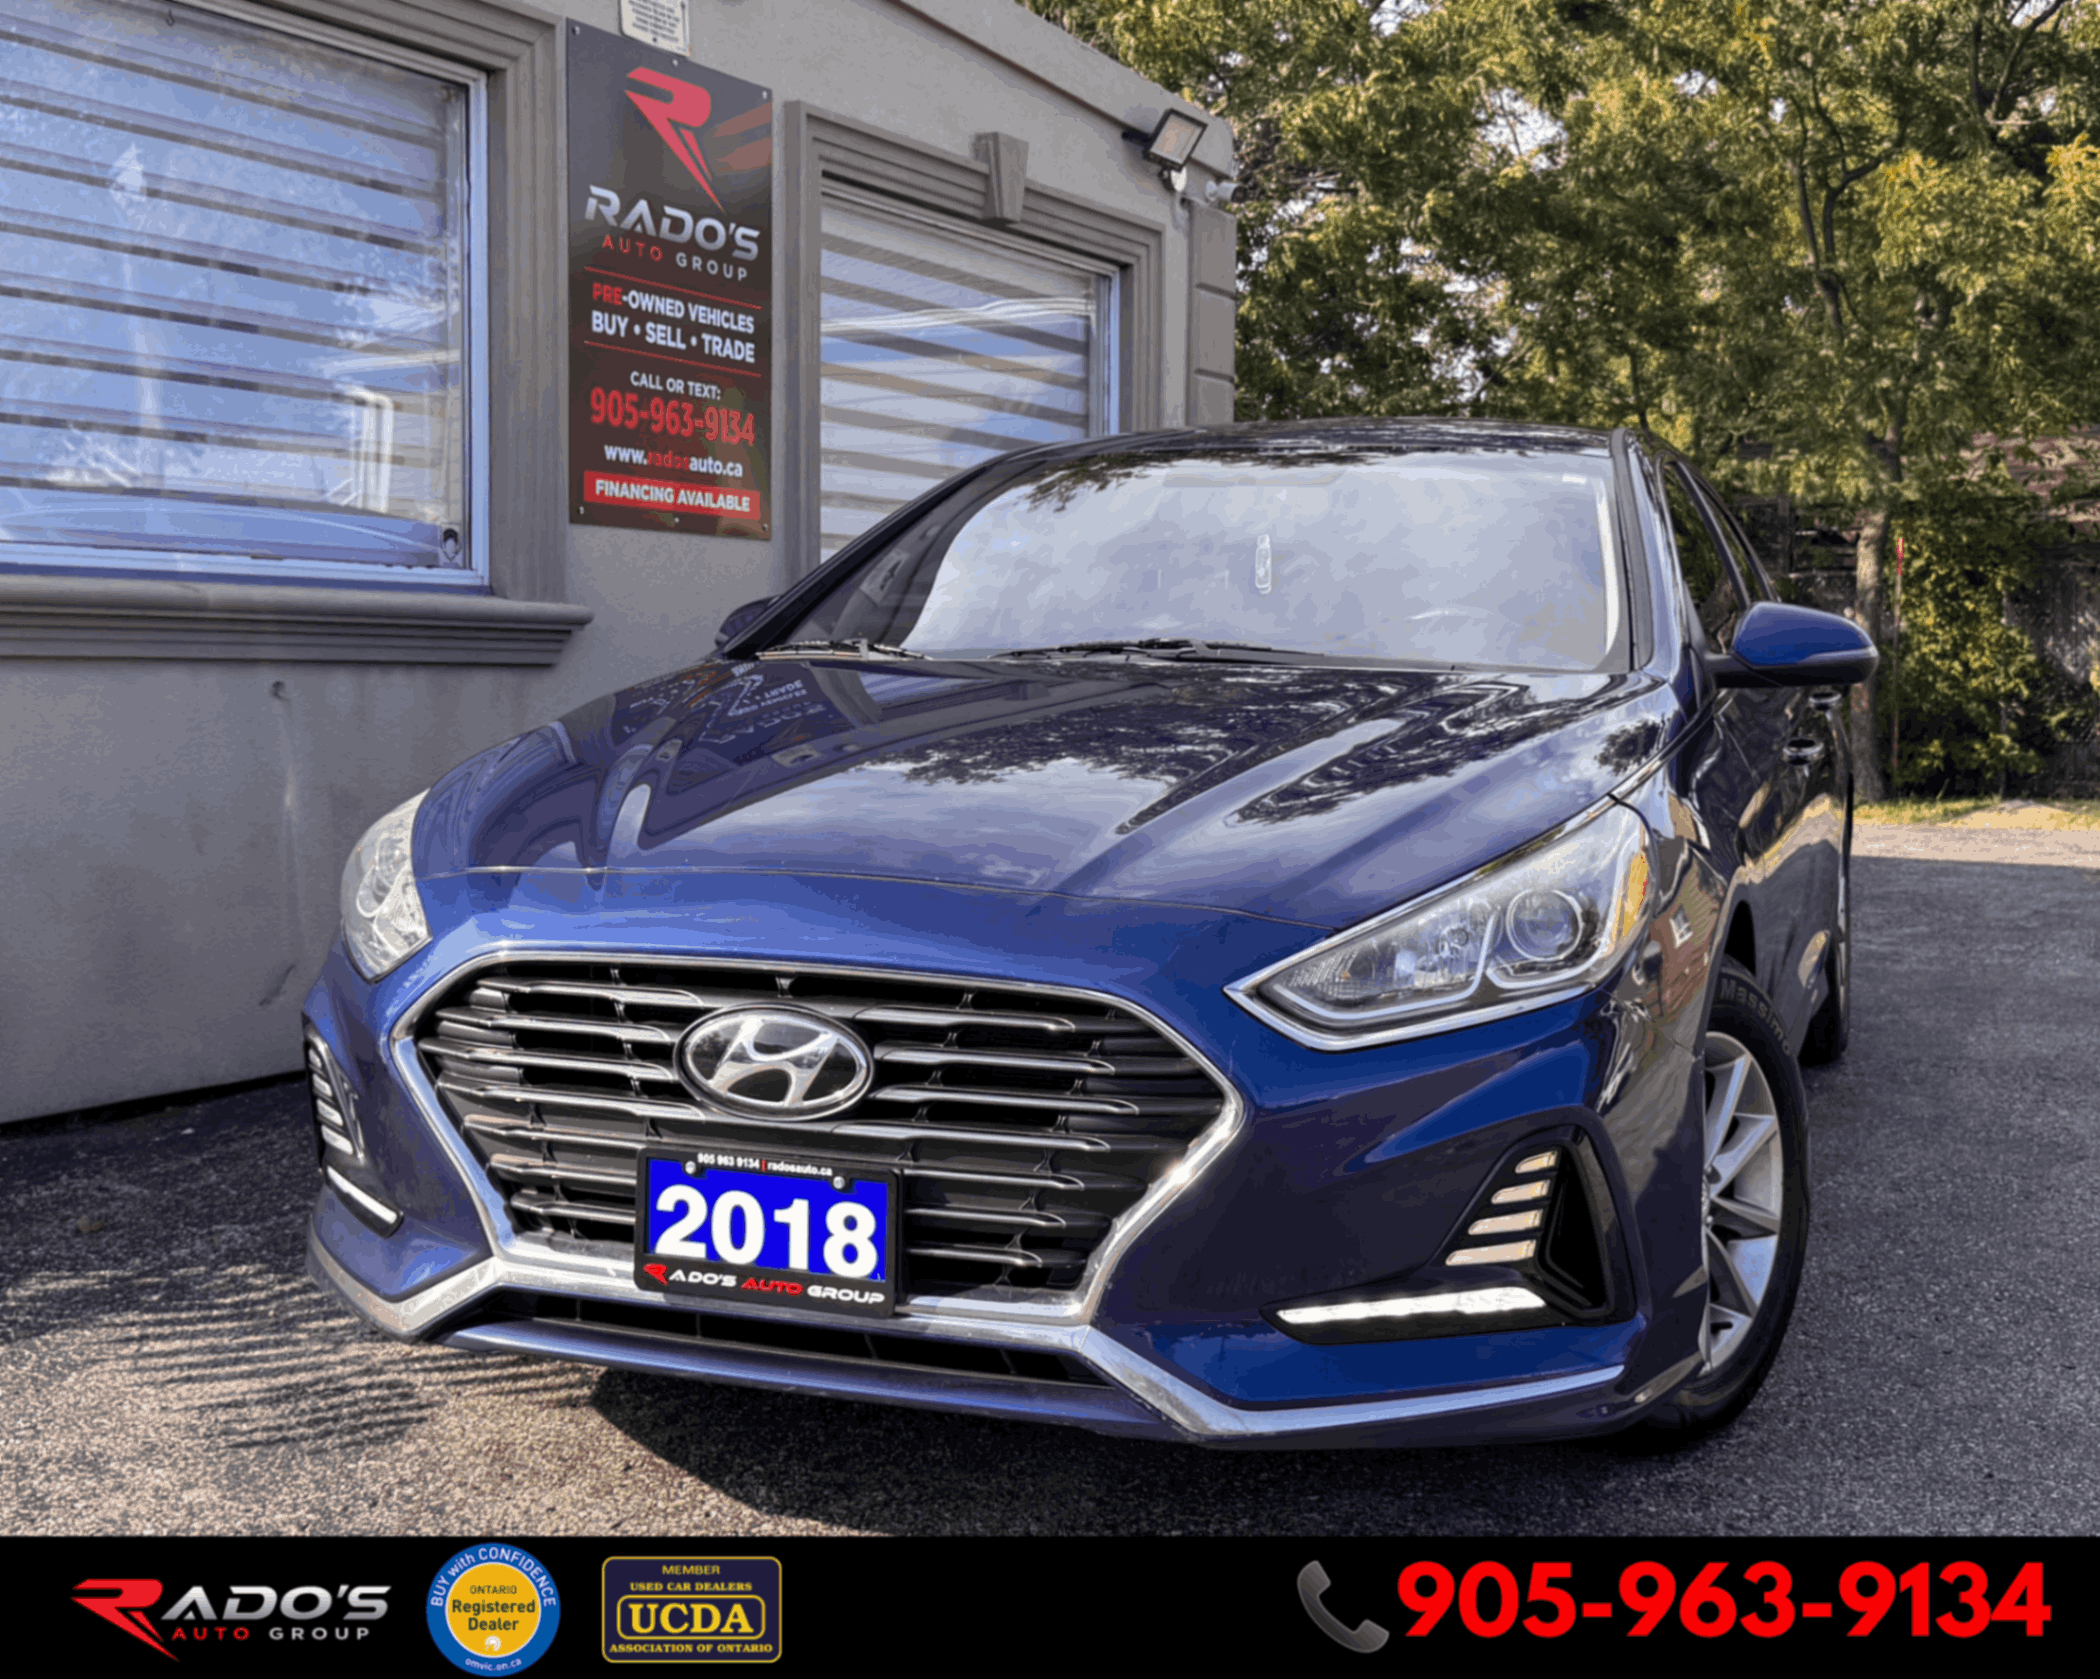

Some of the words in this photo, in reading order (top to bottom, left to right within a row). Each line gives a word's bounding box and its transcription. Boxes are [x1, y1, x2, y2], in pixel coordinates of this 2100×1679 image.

[585, 185, 760, 261] RADO'S
[603, 234, 663, 262] AUTO
[675, 252, 748, 282] GROUP
[592, 283, 685, 318] PRE-OWNED
[688, 302, 755, 334] VEHICLES
[591, 310, 629, 337] BUY
[645, 322, 687, 350] SELL
[701, 333, 755, 363] TRADE
[630, 371, 663, 391] CALL
[666, 378, 684, 394] OR
[688, 381, 721, 401] TEXT:
[590, 387, 755, 446] 905-963-9134
[604, 445, 743, 477] www.radosauto.ca
[595, 479, 675, 503] FINANCING
[677, 489, 751, 512] AVAILABLE
[697, 1152, 716, 1165] 905
[717, 1154, 735, 1167] 963
[736, 1156, 760, 1169] 9134
[767, 1160, 833, 1176] radosauto.ca
[655, 1183, 878, 1278] 2018
[643, 1263, 737, 1287] RADO'S
[740, 1277, 803, 1296] AUTO
[806, 1284, 885, 1304] GROUP
